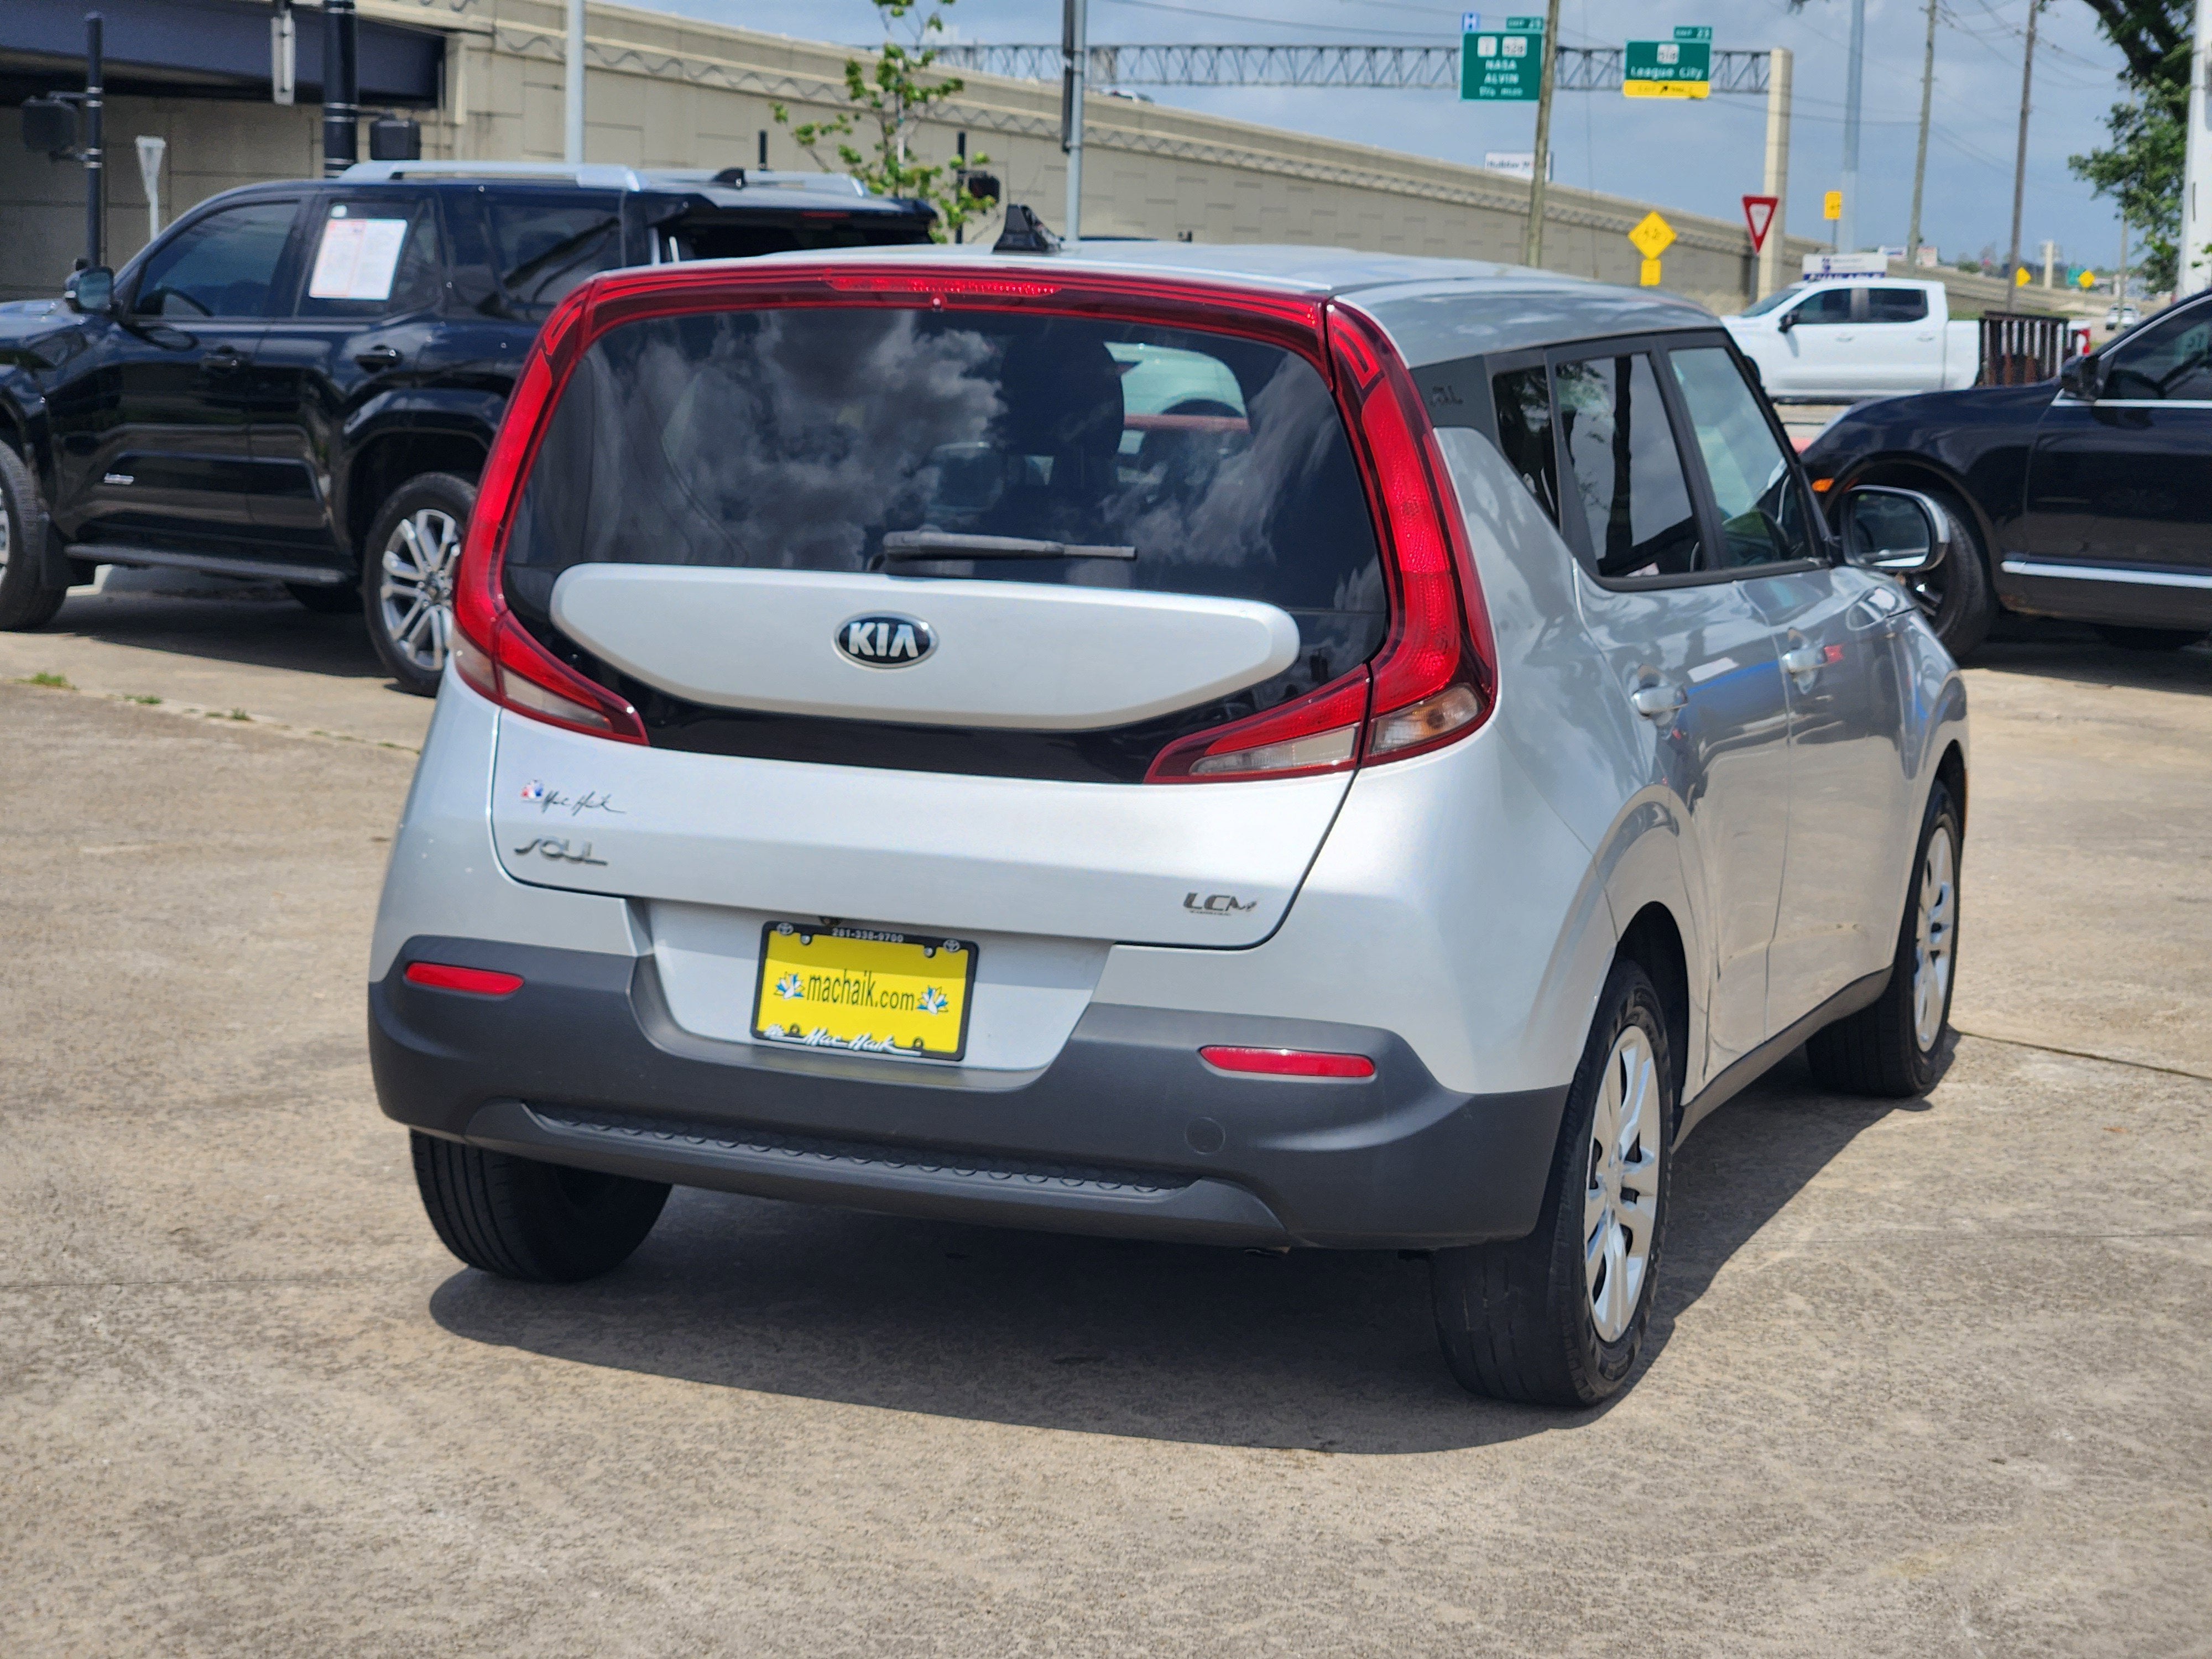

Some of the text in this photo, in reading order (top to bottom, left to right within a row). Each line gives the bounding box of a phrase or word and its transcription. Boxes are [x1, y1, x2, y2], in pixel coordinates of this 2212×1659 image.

[1485, 59, 1517, 70] NASA
[1484, 72, 1520, 84] ALVIN
[1630, 66, 1704, 81] League City
[848, 622, 919, 658] KIA
[806, 968, 915, 1011] machaik.com
